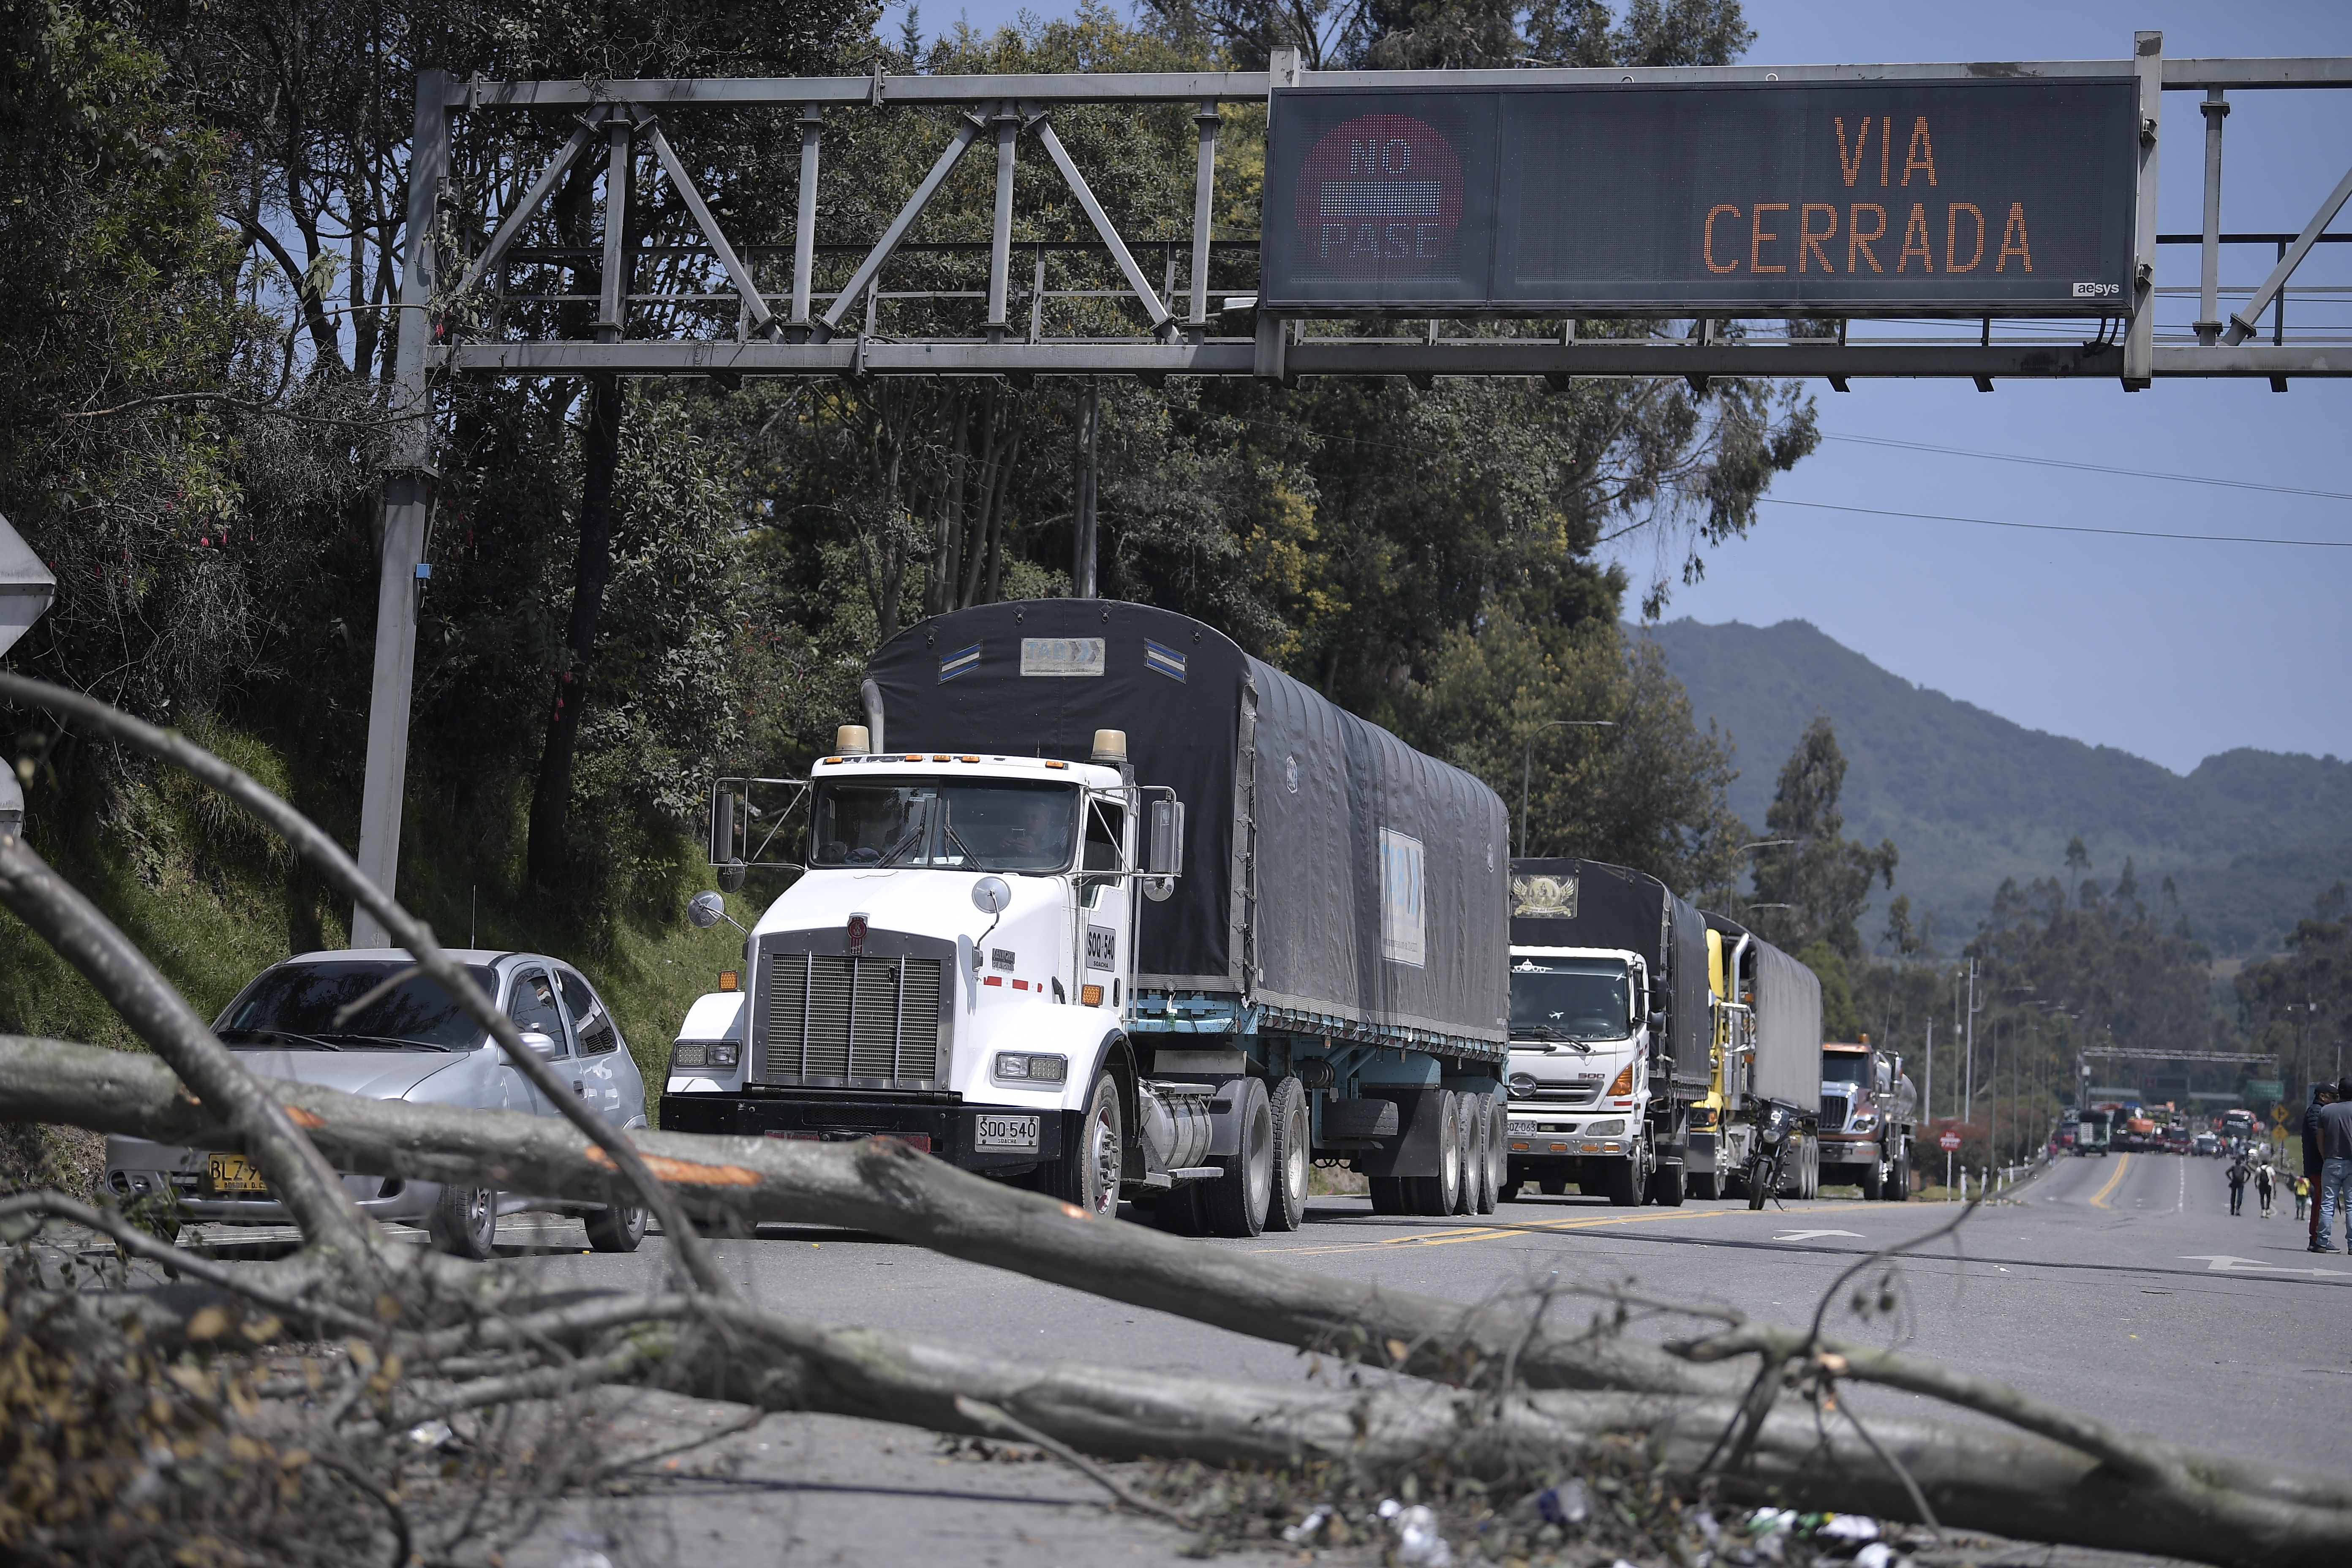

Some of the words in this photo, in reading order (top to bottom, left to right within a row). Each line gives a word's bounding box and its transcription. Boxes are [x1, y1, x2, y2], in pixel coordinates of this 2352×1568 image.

[1351, 139, 1410, 174] NO
[1834, 116, 1937, 186] VIA
[1320, 223, 1438, 258] PASE
[1704, 202, 2033, 273] CERRADA
[2078, 284, 2119, 296] aesys
[1026, 642, 1065, 660] TAB
